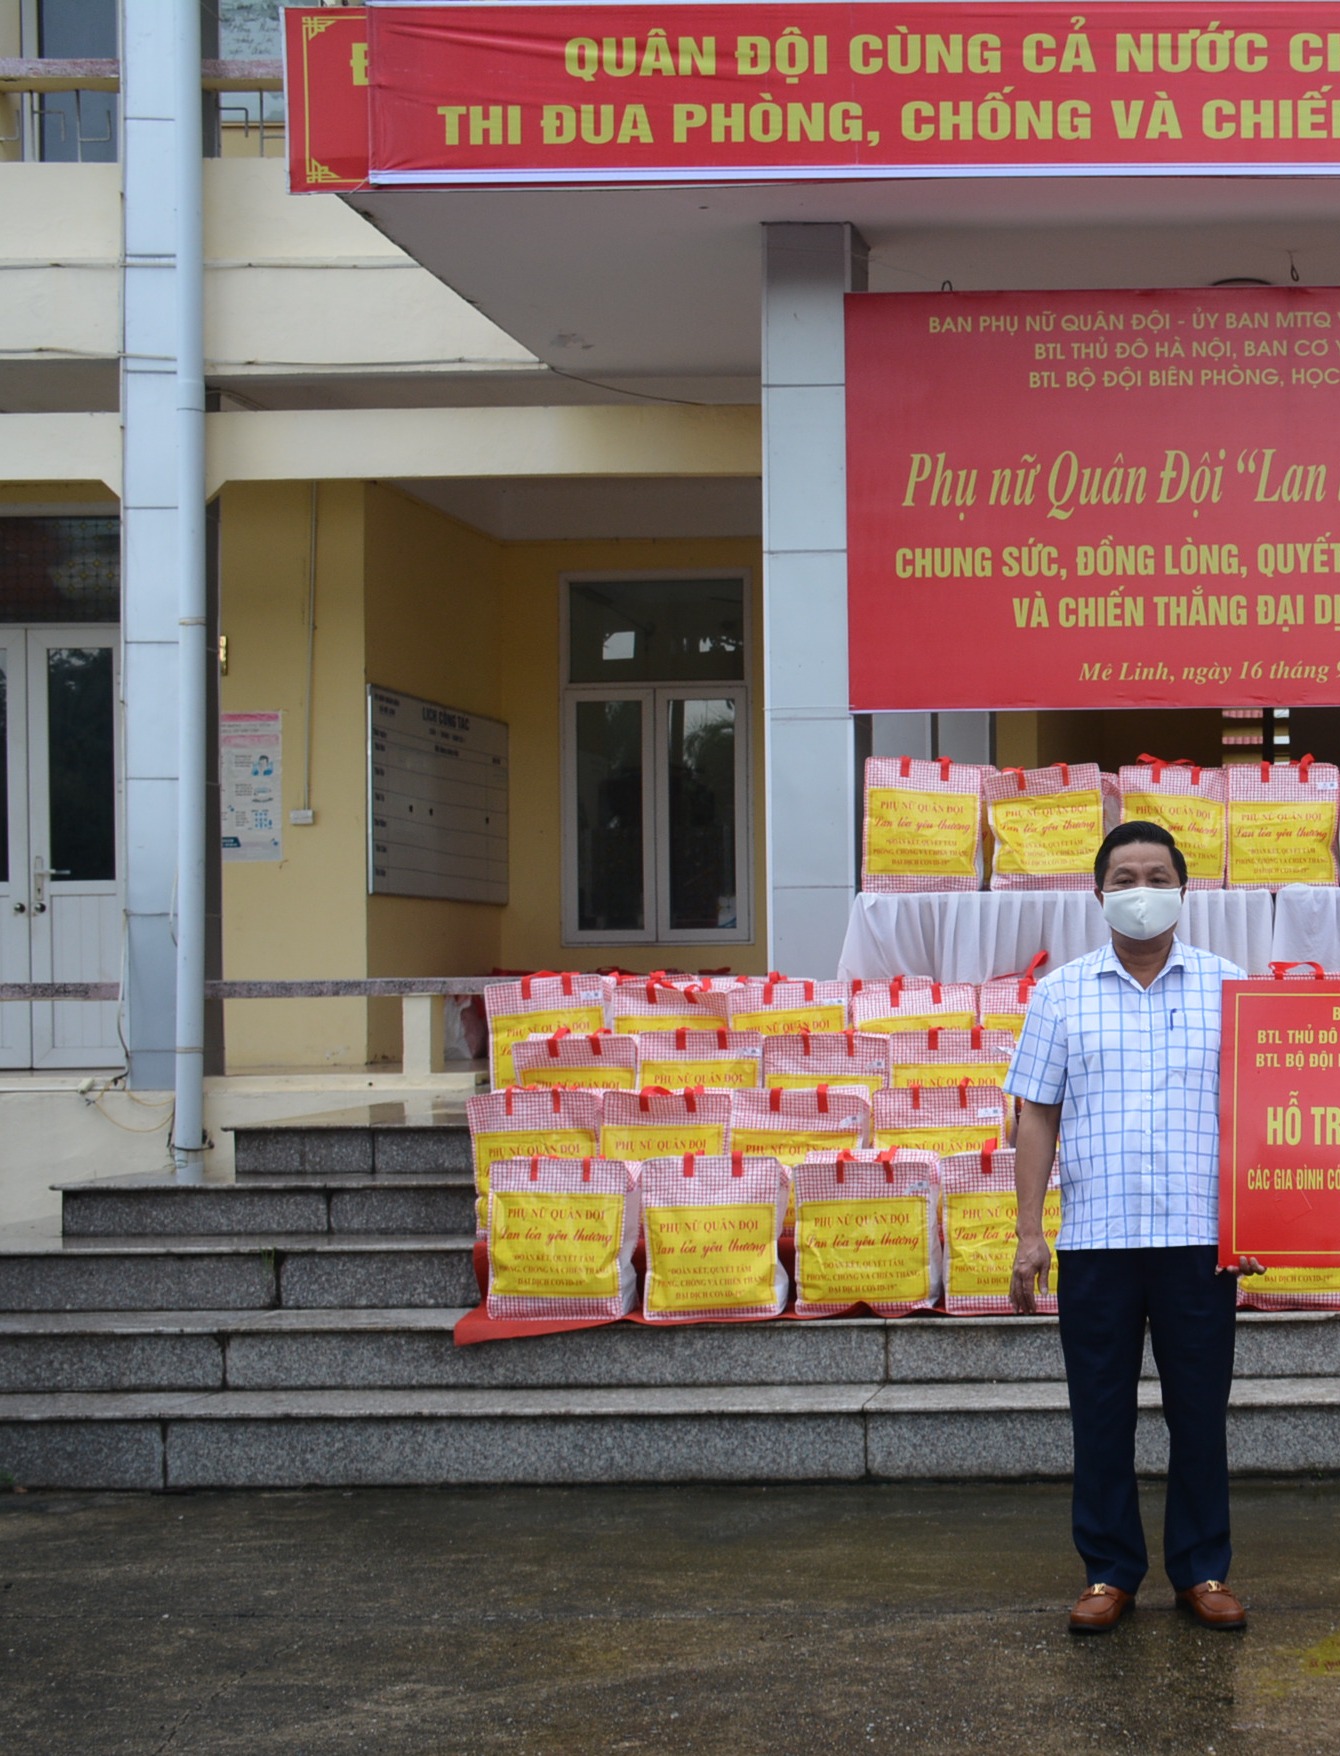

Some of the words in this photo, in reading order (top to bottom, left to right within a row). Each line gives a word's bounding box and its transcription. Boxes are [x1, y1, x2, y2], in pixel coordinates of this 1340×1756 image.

[564, 27, 717, 82] QUÂN
[735, 26, 828, 84] ĐỘI
[849, 25, 1002, 75] CÙNG
[1022, 20, 1097, 74] CẢ
[1115, 20, 1269, 73] NƯỚC
[437, 105, 522, 146] THI
[540, 103, 654, 145] ĐUA
[673, 95, 880, 147] PHÒNG,
[901, 93, 1092, 142] CHỐNG
[1110, 91, 1183, 140] VÀ
[929, 316, 973, 334] BAN
[979, 315, 1019, 336] PHỤ
[1025, 310, 1057, 332] NỮ
[1060, 310, 1125, 332] QUÂN
[1130, 309, 1171, 334] ĐỘI
[1191, 307, 1220, 330] ỦY
[1225, 311, 1270, 330] BAN
[1275, 310, 1332, 329] MTTQ
[1034, 342, 1066, 360] BTL
[1071, 337, 1109, 360] THỦ
[1115, 337, 1149, 359] ĐÔ
[1155, 336, 1186, 358] HÀ
[1191, 336, 1237, 361] NỘI,
[1243, 339, 1289, 358] BAN
[1294, 338, 1330, 357] CƠ
[1029, 371, 1061, 389] BTL
[1066, 367, 1097, 391] BỘ
[1102, 365, 1143, 390] ĐỘI
[1148, 365, 1194, 387] BIÊN
[1200, 364, 1285, 387] PHÒNG,
[1291, 367, 1340, 389] HỌC
[902, 452, 978, 521] Phụ
[989, 453, 1042, 506] nữ
[1047, 450, 1148, 521] Quân
[1156, 448, 1227, 518] Đội
[1236, 448, 1328, 503] “Lan
[895, 546, 993, 579] CHUNG
[1002, 535, 1068, 580] SỨC,
[1075, 533, 1156, 577] ĐỒNG
[1164, 536, 1248, 578] LÒNG,
[1012, 591, 1050, 628] VÀ
[1058, 584, 1145, 628] CHIẾN
[1153, 585, 1248, 627] THẮNG
[1256, 594, 1305, 633] ĐẠI
[1079, 662, 1113, 681] Mê
[1119, 661, 1176, 682] Linh,
[1182, 662, 1233, 685] ngày
[1239, 660, 1263, 680] 16
[1269, 660, 1330, 683] tháng
[1257, 1029, 1283, 1045] BTL
[1287, 1024, 1315, 1045] THỦ
[1318, 1027, 1339, 1045] ĐÔ
[1255, 1053, 1281, 1068] BTL
[1285, 1050, 1305, 1070] BỘ
[1309, 1050, 1334, 1071] ĐỘI
[1266, 1090, 1302, 1146] HỖ
[1247, 1168, 1271, 1190] CÁC
[1273, 1168, 1293, 1190] GIA
[1295, 1168, 1324, 1190] ĐÌNH
[660, 1222, 679, 1234] PHỤ
[704, 1218, 736, 1233] QUÂN
[739, 1219, 759, 1233] ĐỘI
[814, 1217, 832, 1228] PHỤ
[855, 1212, 887, 1227] QUÂN
[890, 1213, 910, 1226] ĐỘI
